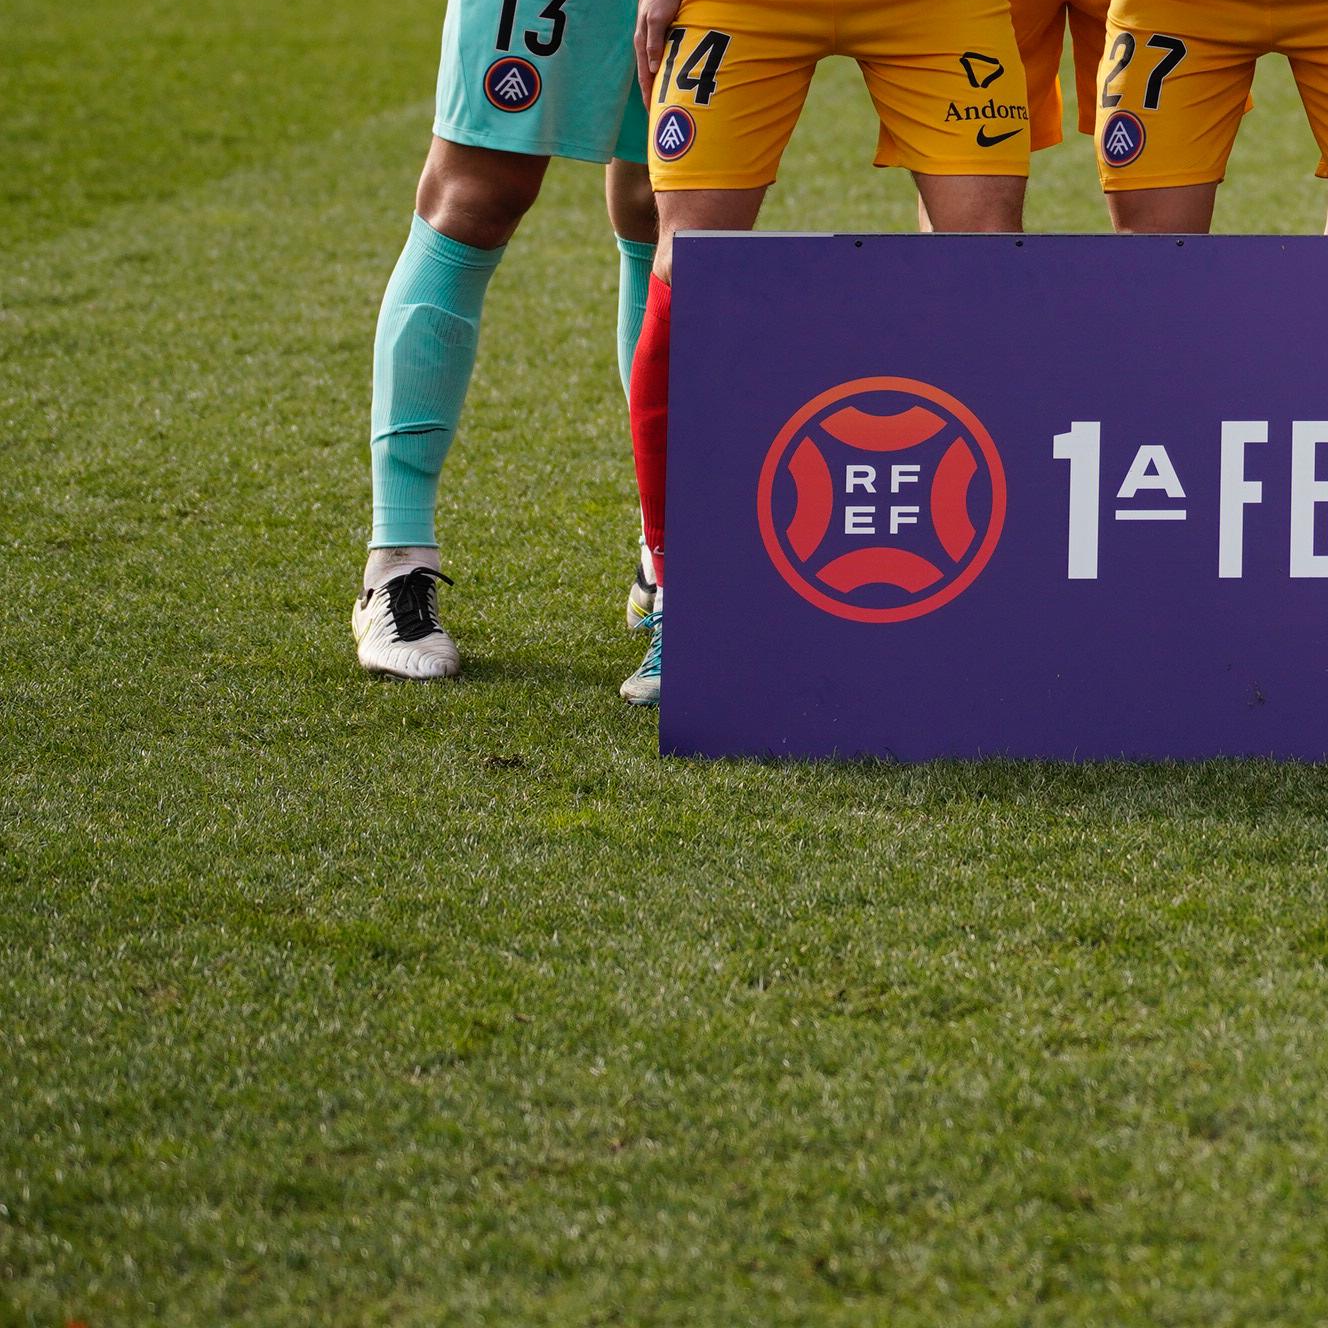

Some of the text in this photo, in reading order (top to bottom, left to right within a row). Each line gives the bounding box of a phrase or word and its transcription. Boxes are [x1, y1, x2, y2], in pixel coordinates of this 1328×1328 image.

[656, 27, 731, 106] 14
[1102, 32, 1188, 111] 27
[944, 98, 1029, 122] Andorra
